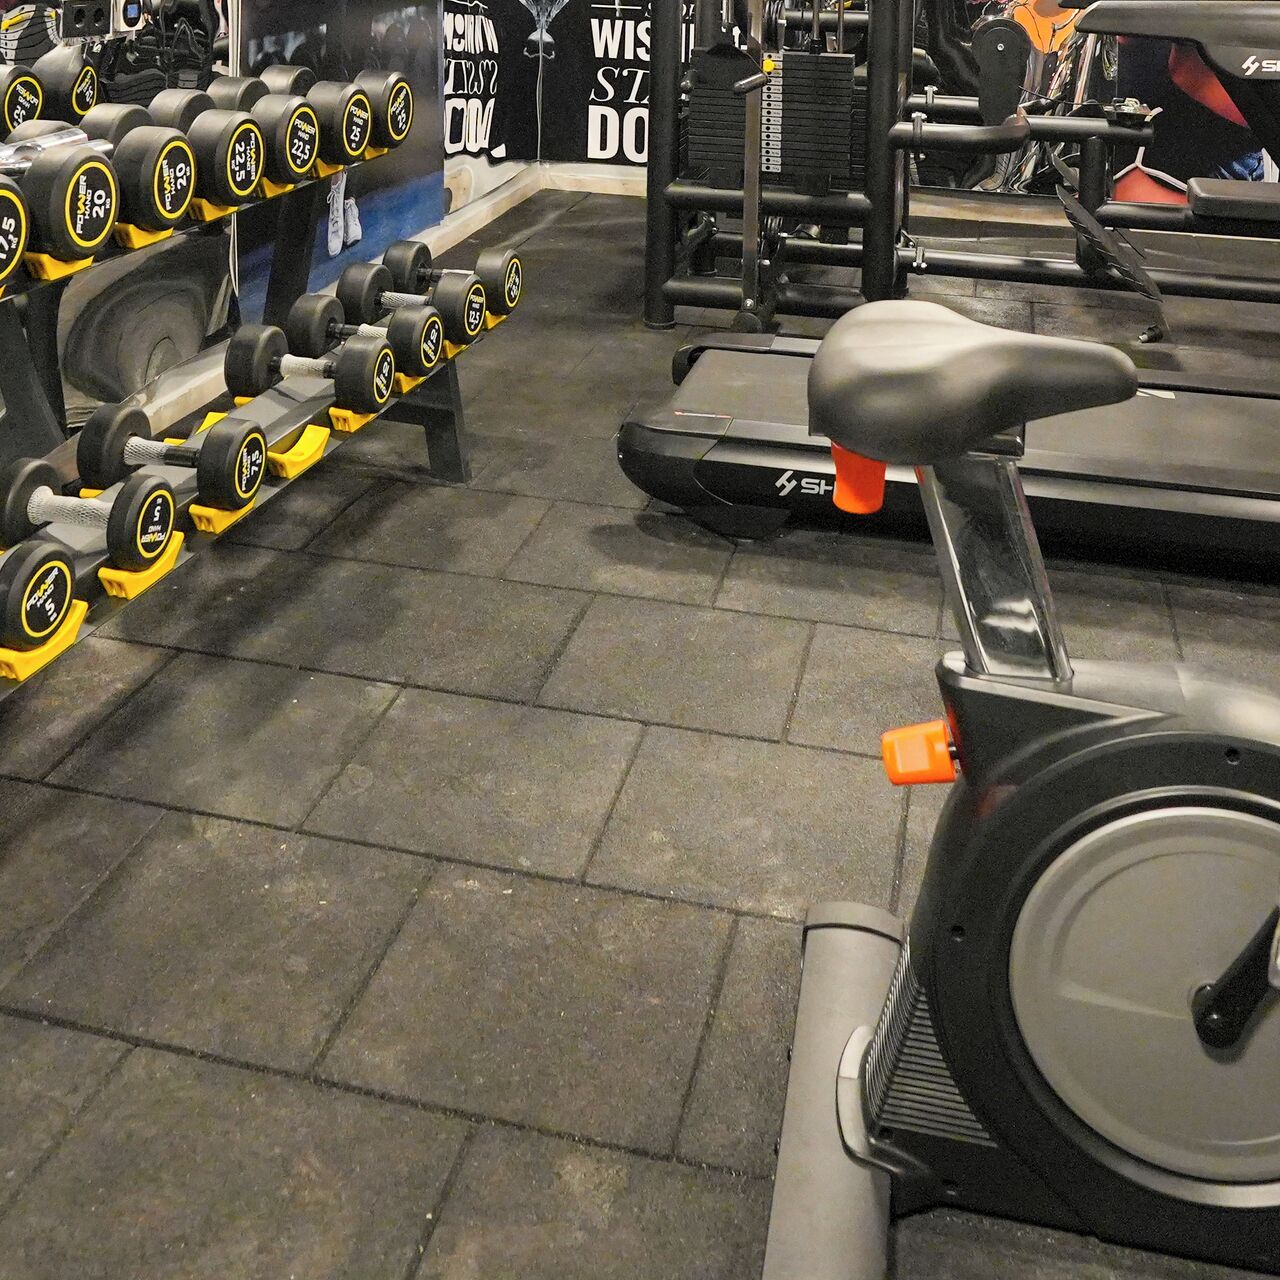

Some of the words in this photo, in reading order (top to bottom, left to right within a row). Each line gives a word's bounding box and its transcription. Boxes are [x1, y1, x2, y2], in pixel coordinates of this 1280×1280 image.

[350, 125, 361, 142] 25
[162, 159, 172, 211] POWER
[176, 163, 187, 190] 20
[76, 174, 87, 234] POWER
[84, 189, 92, 219] HAND
[92, 190, 106, 218] 20
[801, 478, 833, 495] SH
[153, 506, 161, 521] 5
[27, 567, 59, 611] POWER
[45, 598, 55, 616] 5
